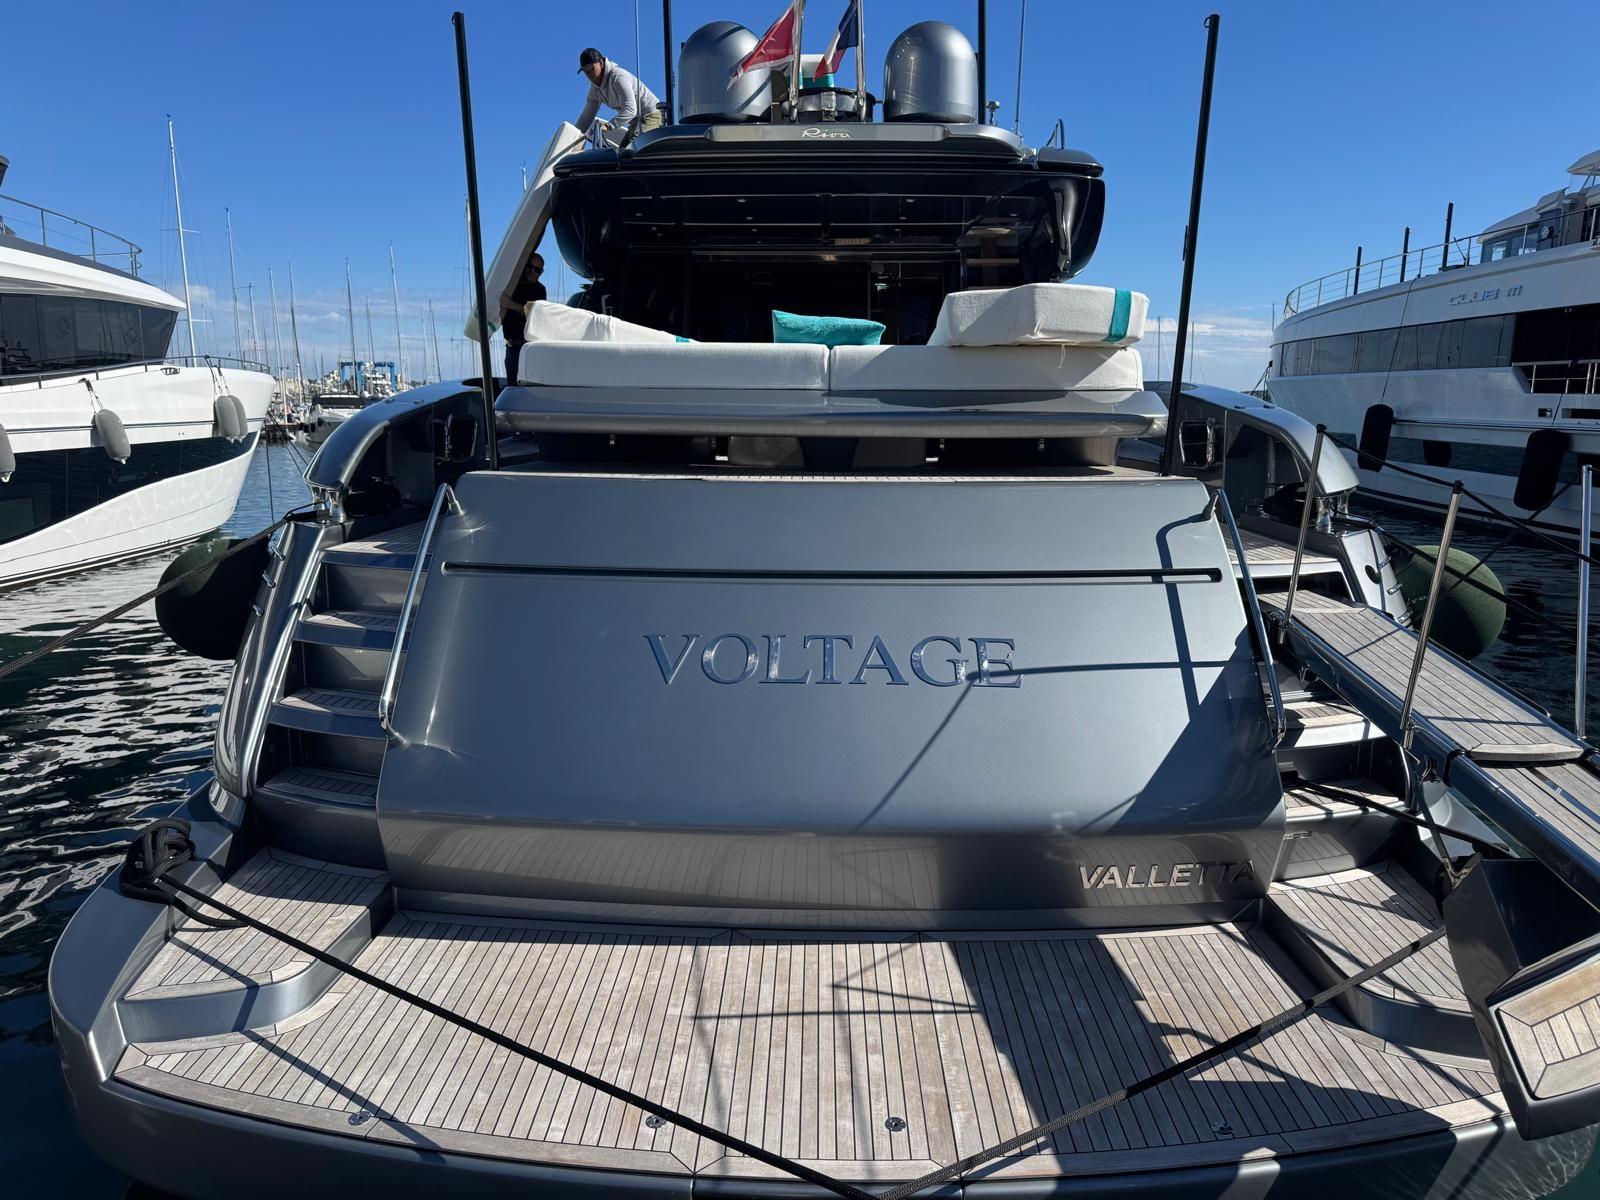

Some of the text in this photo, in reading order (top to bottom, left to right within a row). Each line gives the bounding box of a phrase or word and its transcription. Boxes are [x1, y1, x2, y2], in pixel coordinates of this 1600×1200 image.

[801, 127, 852, 138] Riva
[1449, 288, 1500, 306] CLUB
[642, 633, 1023, 689] VOLTAGE
[1079, 859, 1255, 890] VALLETTA
